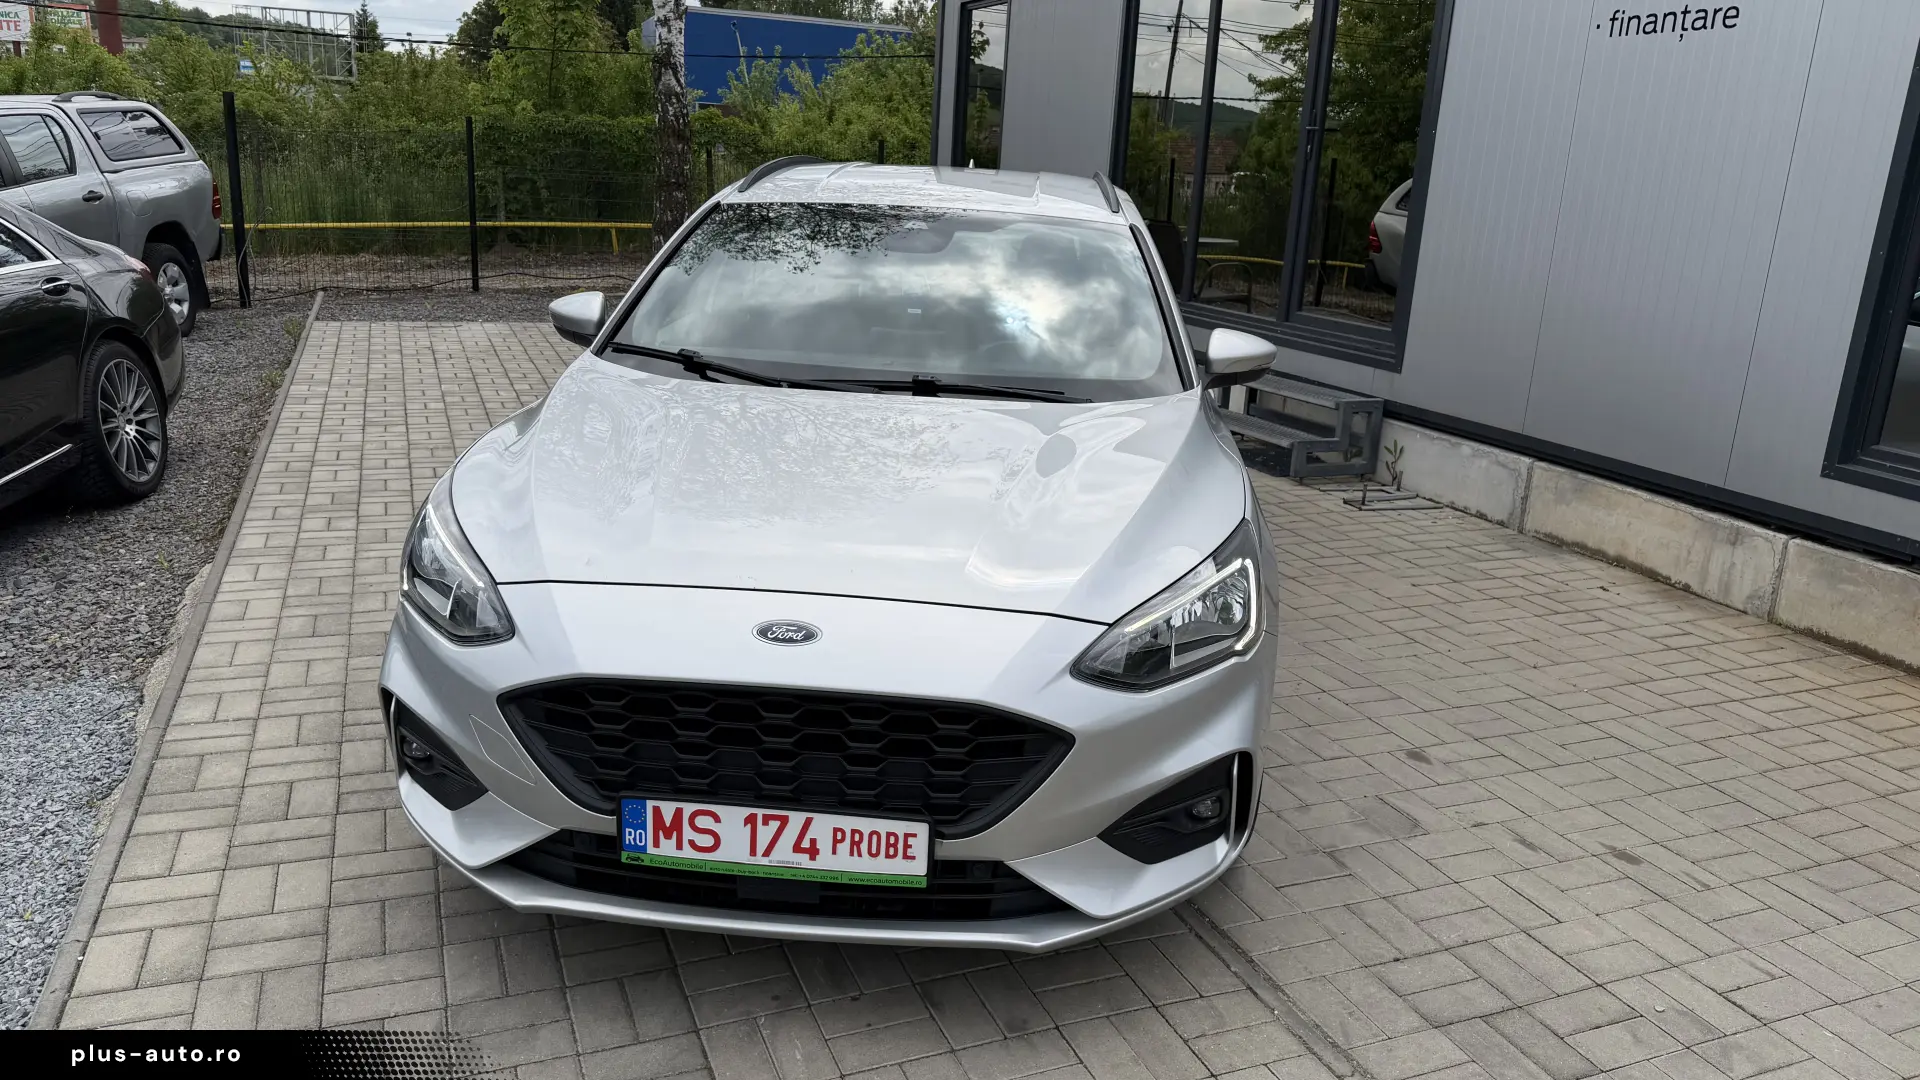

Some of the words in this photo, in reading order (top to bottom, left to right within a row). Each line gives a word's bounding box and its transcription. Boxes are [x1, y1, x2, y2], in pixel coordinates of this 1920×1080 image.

[1608, 4, 1740, 42] finanțare
[767, 625, 806, 641] Ford
[625, 827, 646, 846] RO
[652, 804, 722, 854] MS
[743, 812, 820, 862] 174
[831, 826, 918, 860] PROBE
[649, 859, 704, 871] EcoAutomobile
[848, 876, 923, 886] www.ecoautomobile.ro
